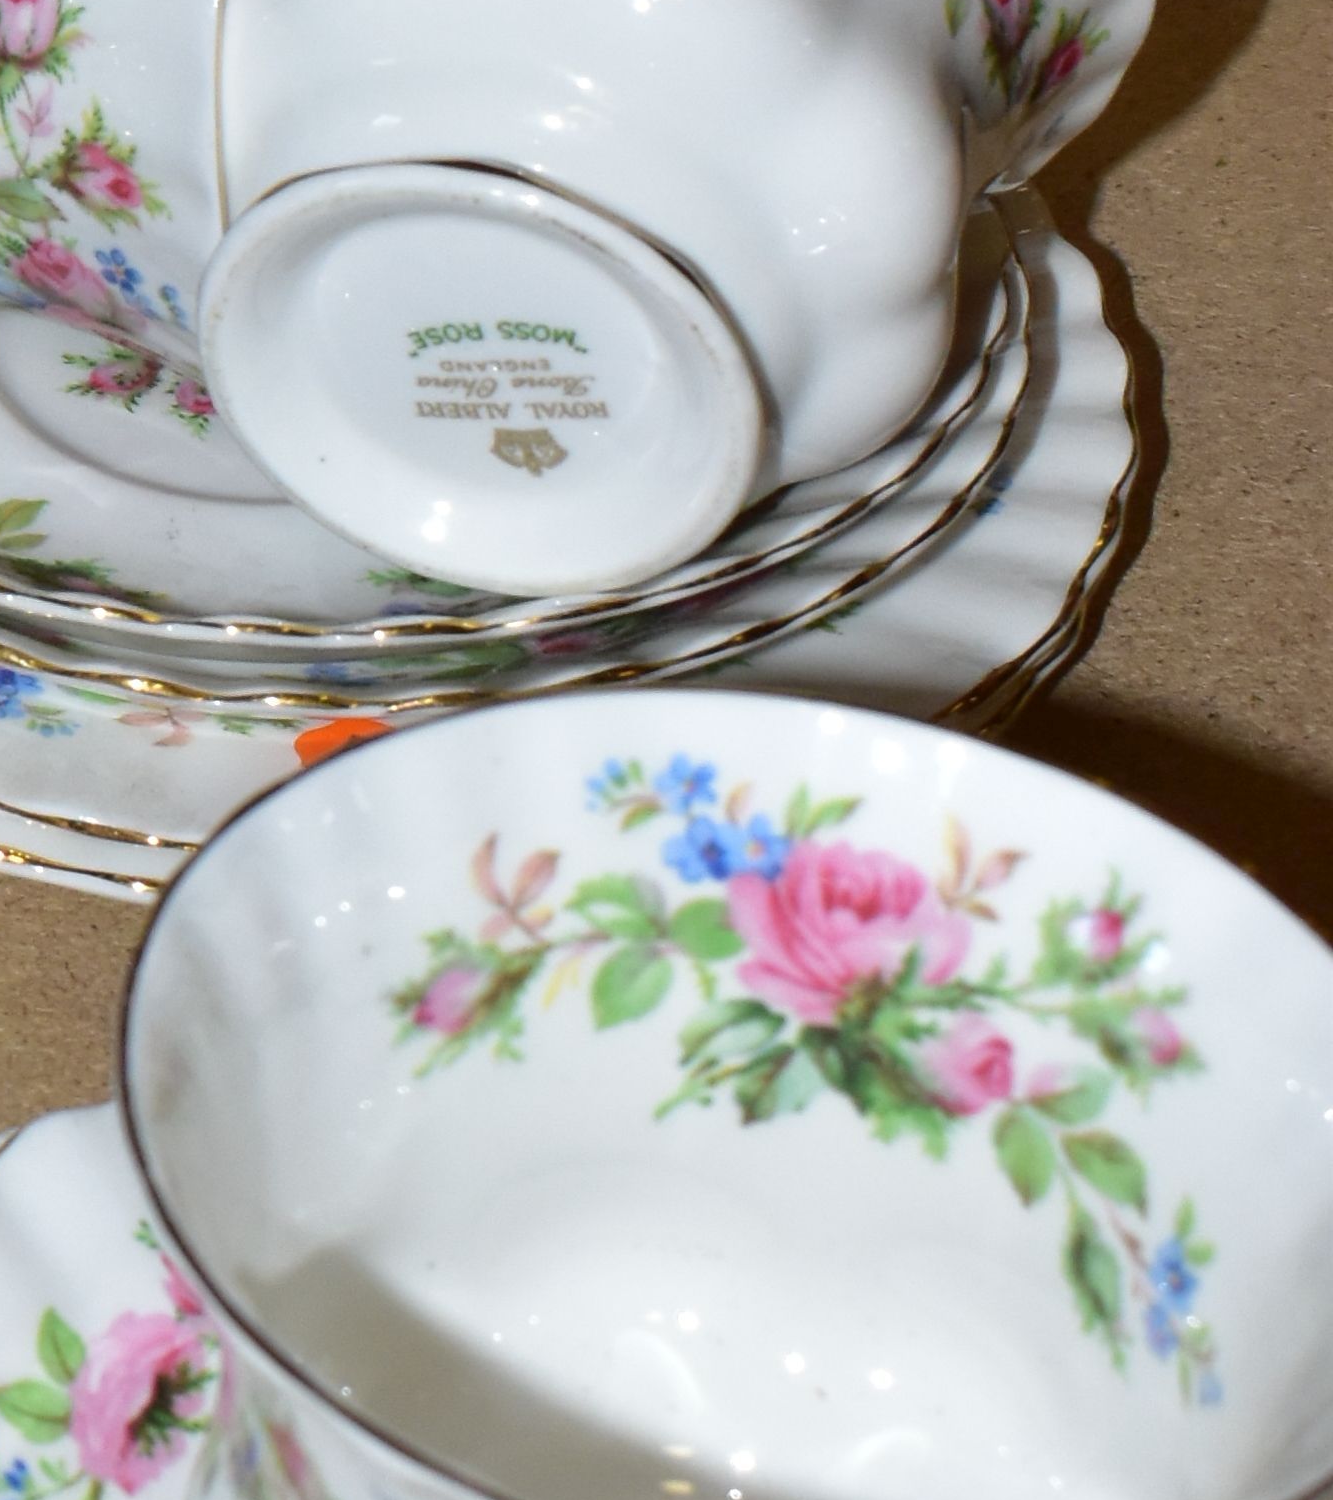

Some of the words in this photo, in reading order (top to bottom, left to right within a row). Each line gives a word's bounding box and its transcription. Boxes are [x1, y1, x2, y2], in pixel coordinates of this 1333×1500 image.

[439, 359, 550, 372] ENGLAND
[415, 375, 497, 398] China
[512, 376, 594, 395] Bone
[414, 402, 510, 419] ALBERT
[525, 402, 609, 419] ROYAL
